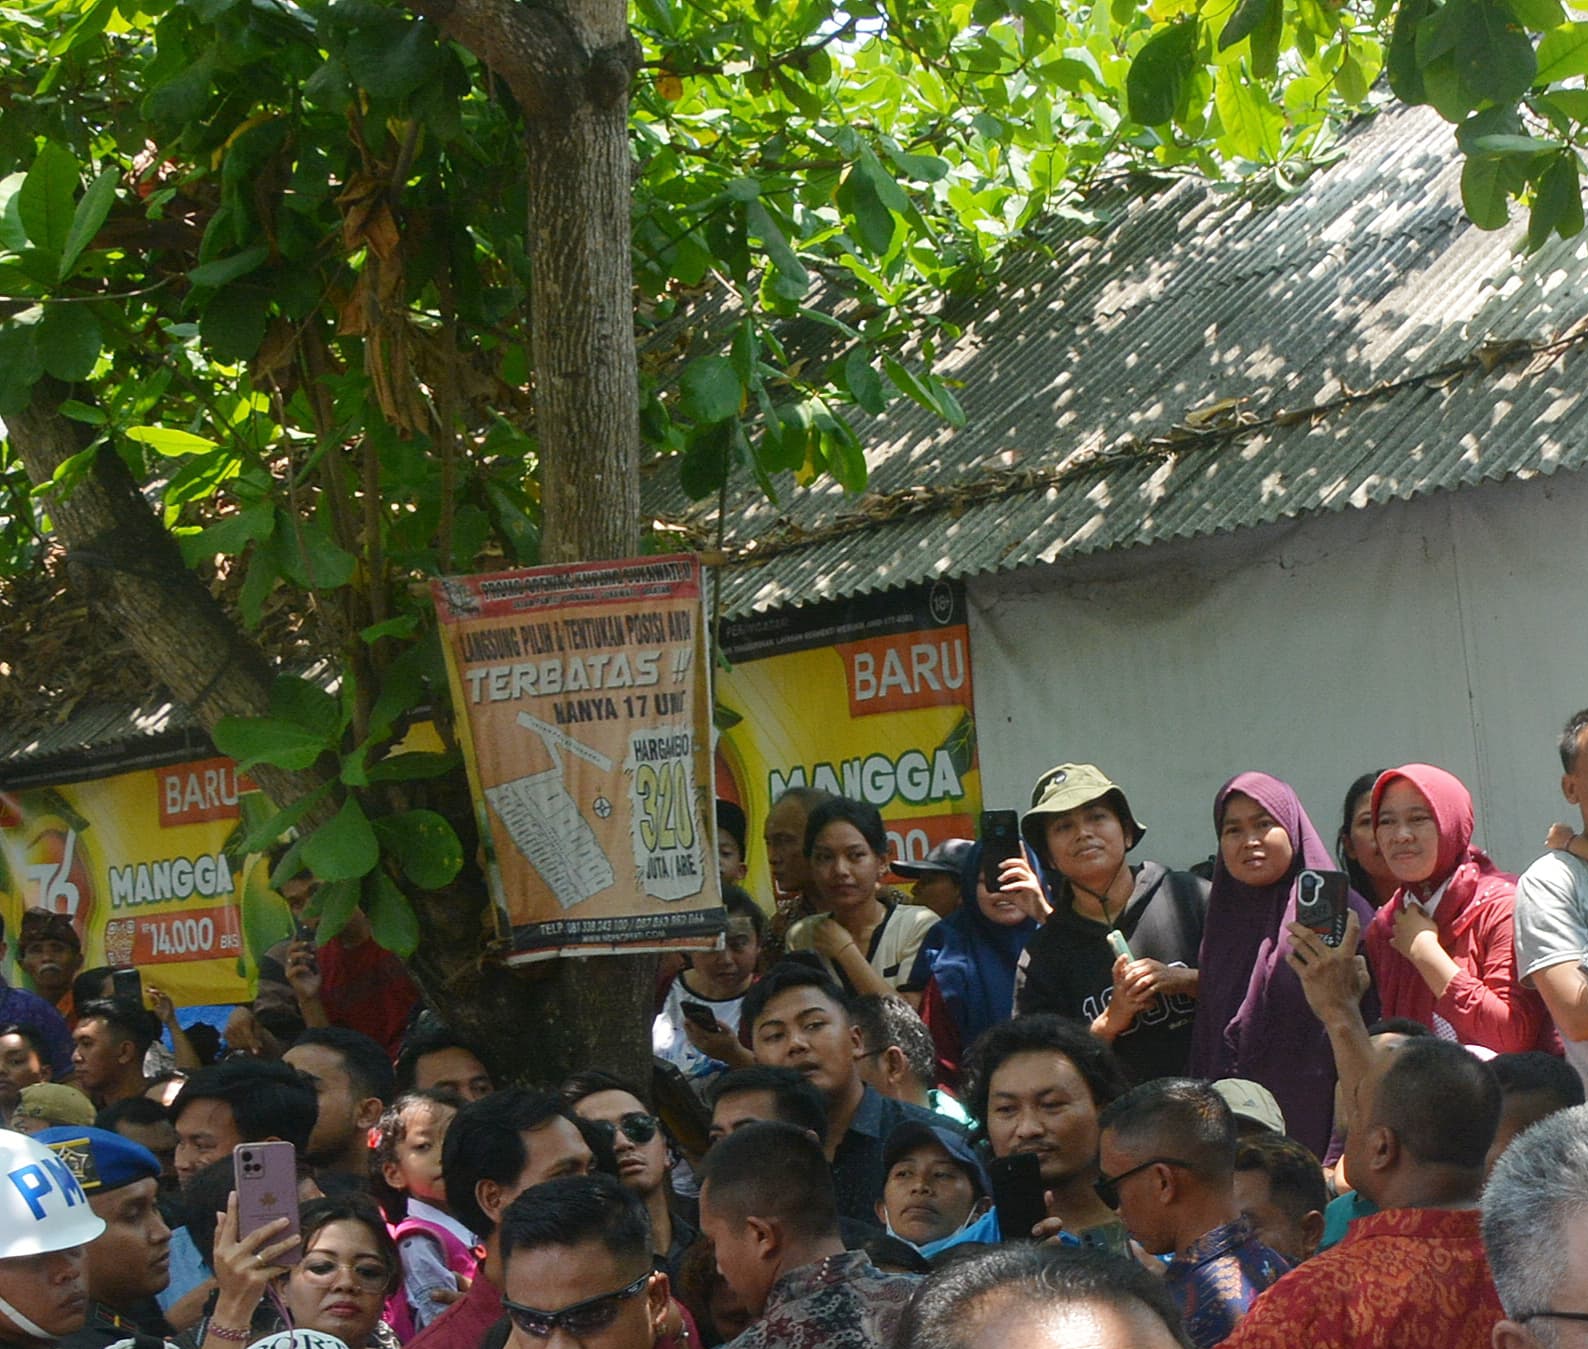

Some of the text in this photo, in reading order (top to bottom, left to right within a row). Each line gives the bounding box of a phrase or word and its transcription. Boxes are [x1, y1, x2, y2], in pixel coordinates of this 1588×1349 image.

[519, 621, 554, 656] PILIH
[563, 615, 625, 651] TENTUKAN
[464, 650, 662, 705] TERBATAS
[853, 639, 966, 702] BARU
[553, 696, 619, 725] HANYA
[623, 695, 648, 720] 17
[165, 767, 239, 815] BARU
[770, 749, 966, 808] MANGGA
[636, 759, 695, 854] 320
[109, 853, 235, 907] MANGGA
[646, 857, 670, 879] JUTA
[675, 853, 698, 878] ARE
[149, 916, 214, 956] 14.000
[8, 1156, 85, 1221] PM
